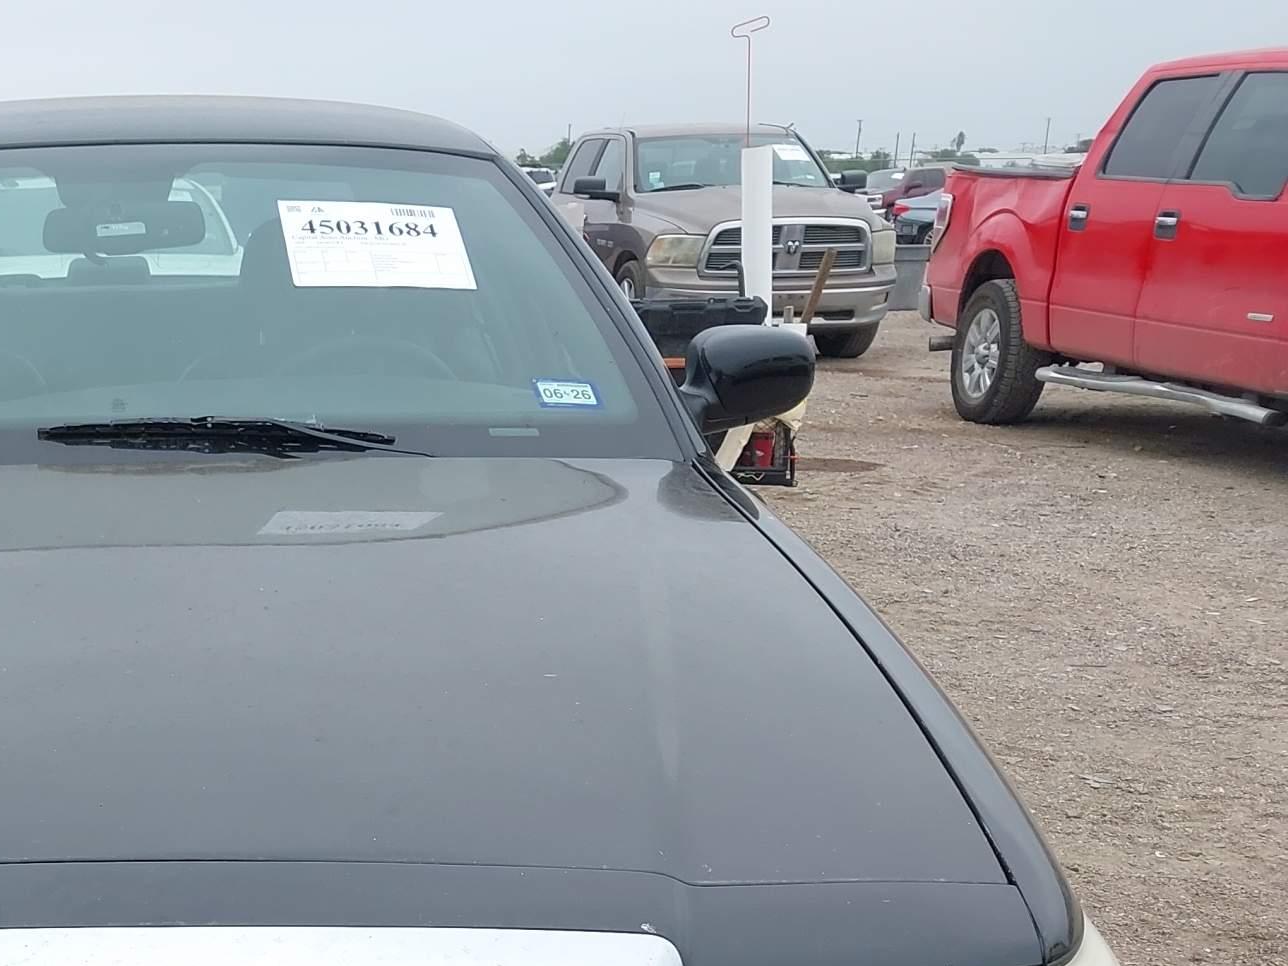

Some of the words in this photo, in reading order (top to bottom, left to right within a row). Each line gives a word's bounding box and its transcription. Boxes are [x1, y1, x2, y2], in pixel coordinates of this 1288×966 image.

[301, 219, 439, 238] 45031684
[543, 388, 564, 399] 06
[570, 389, 592, 400] 26
